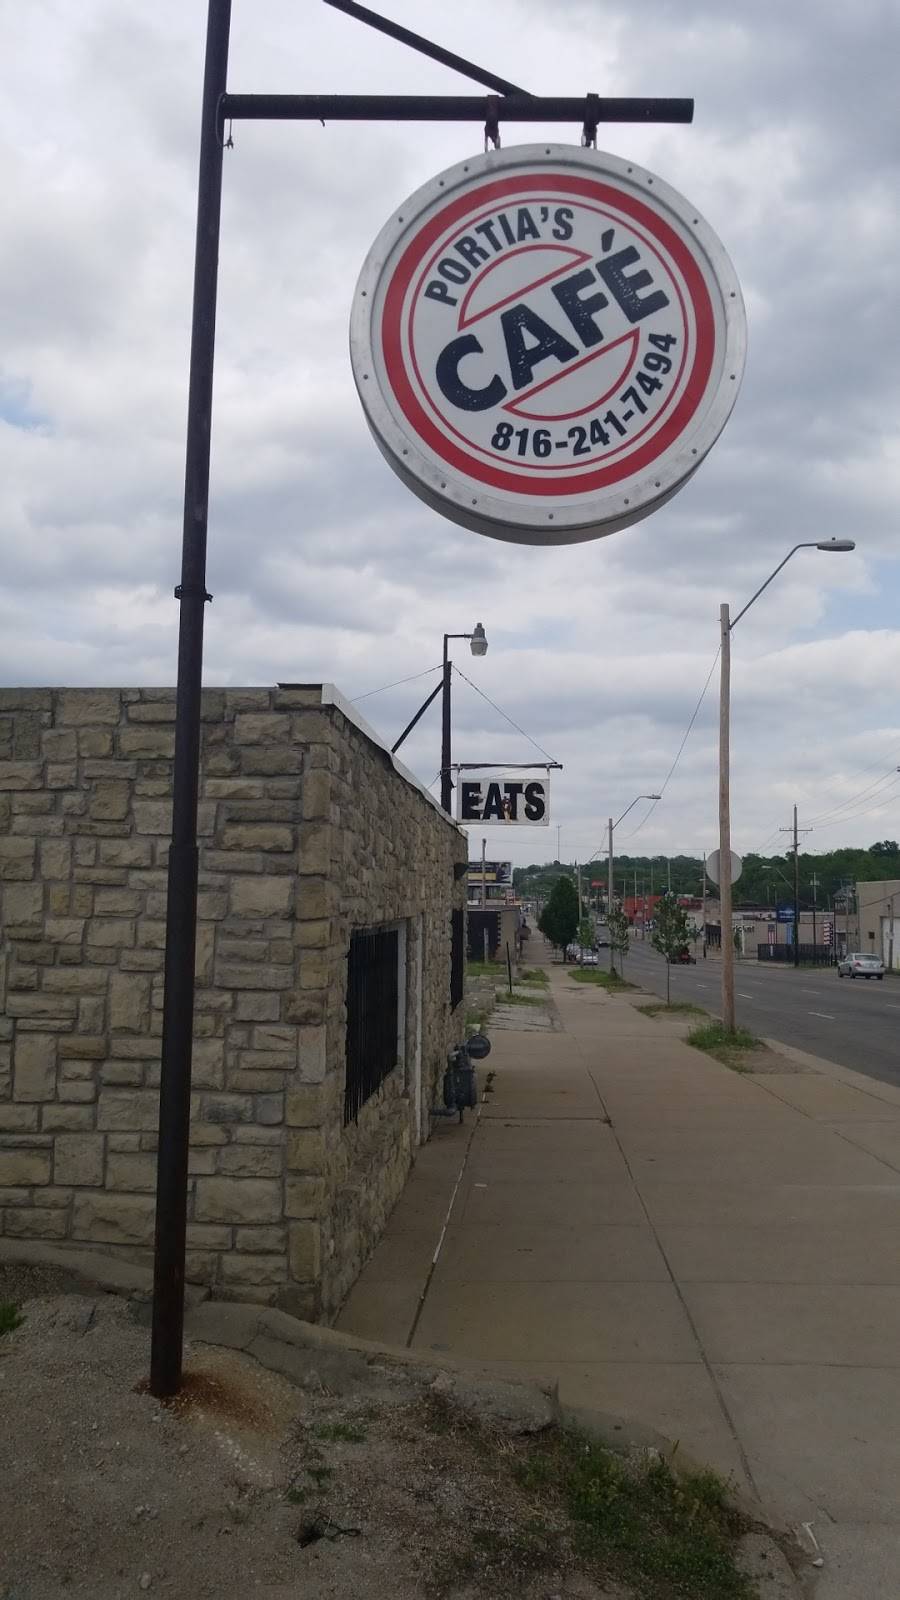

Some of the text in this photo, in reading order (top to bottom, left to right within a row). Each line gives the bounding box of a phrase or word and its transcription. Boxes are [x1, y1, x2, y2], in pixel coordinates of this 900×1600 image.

[424, 206, 574, 307] PORTIA'S
[435, 229, 670, 412] CAFÉ
[491, 332, 677, 458] 816-241-7494
[462, 782, 545, 820] EATS
